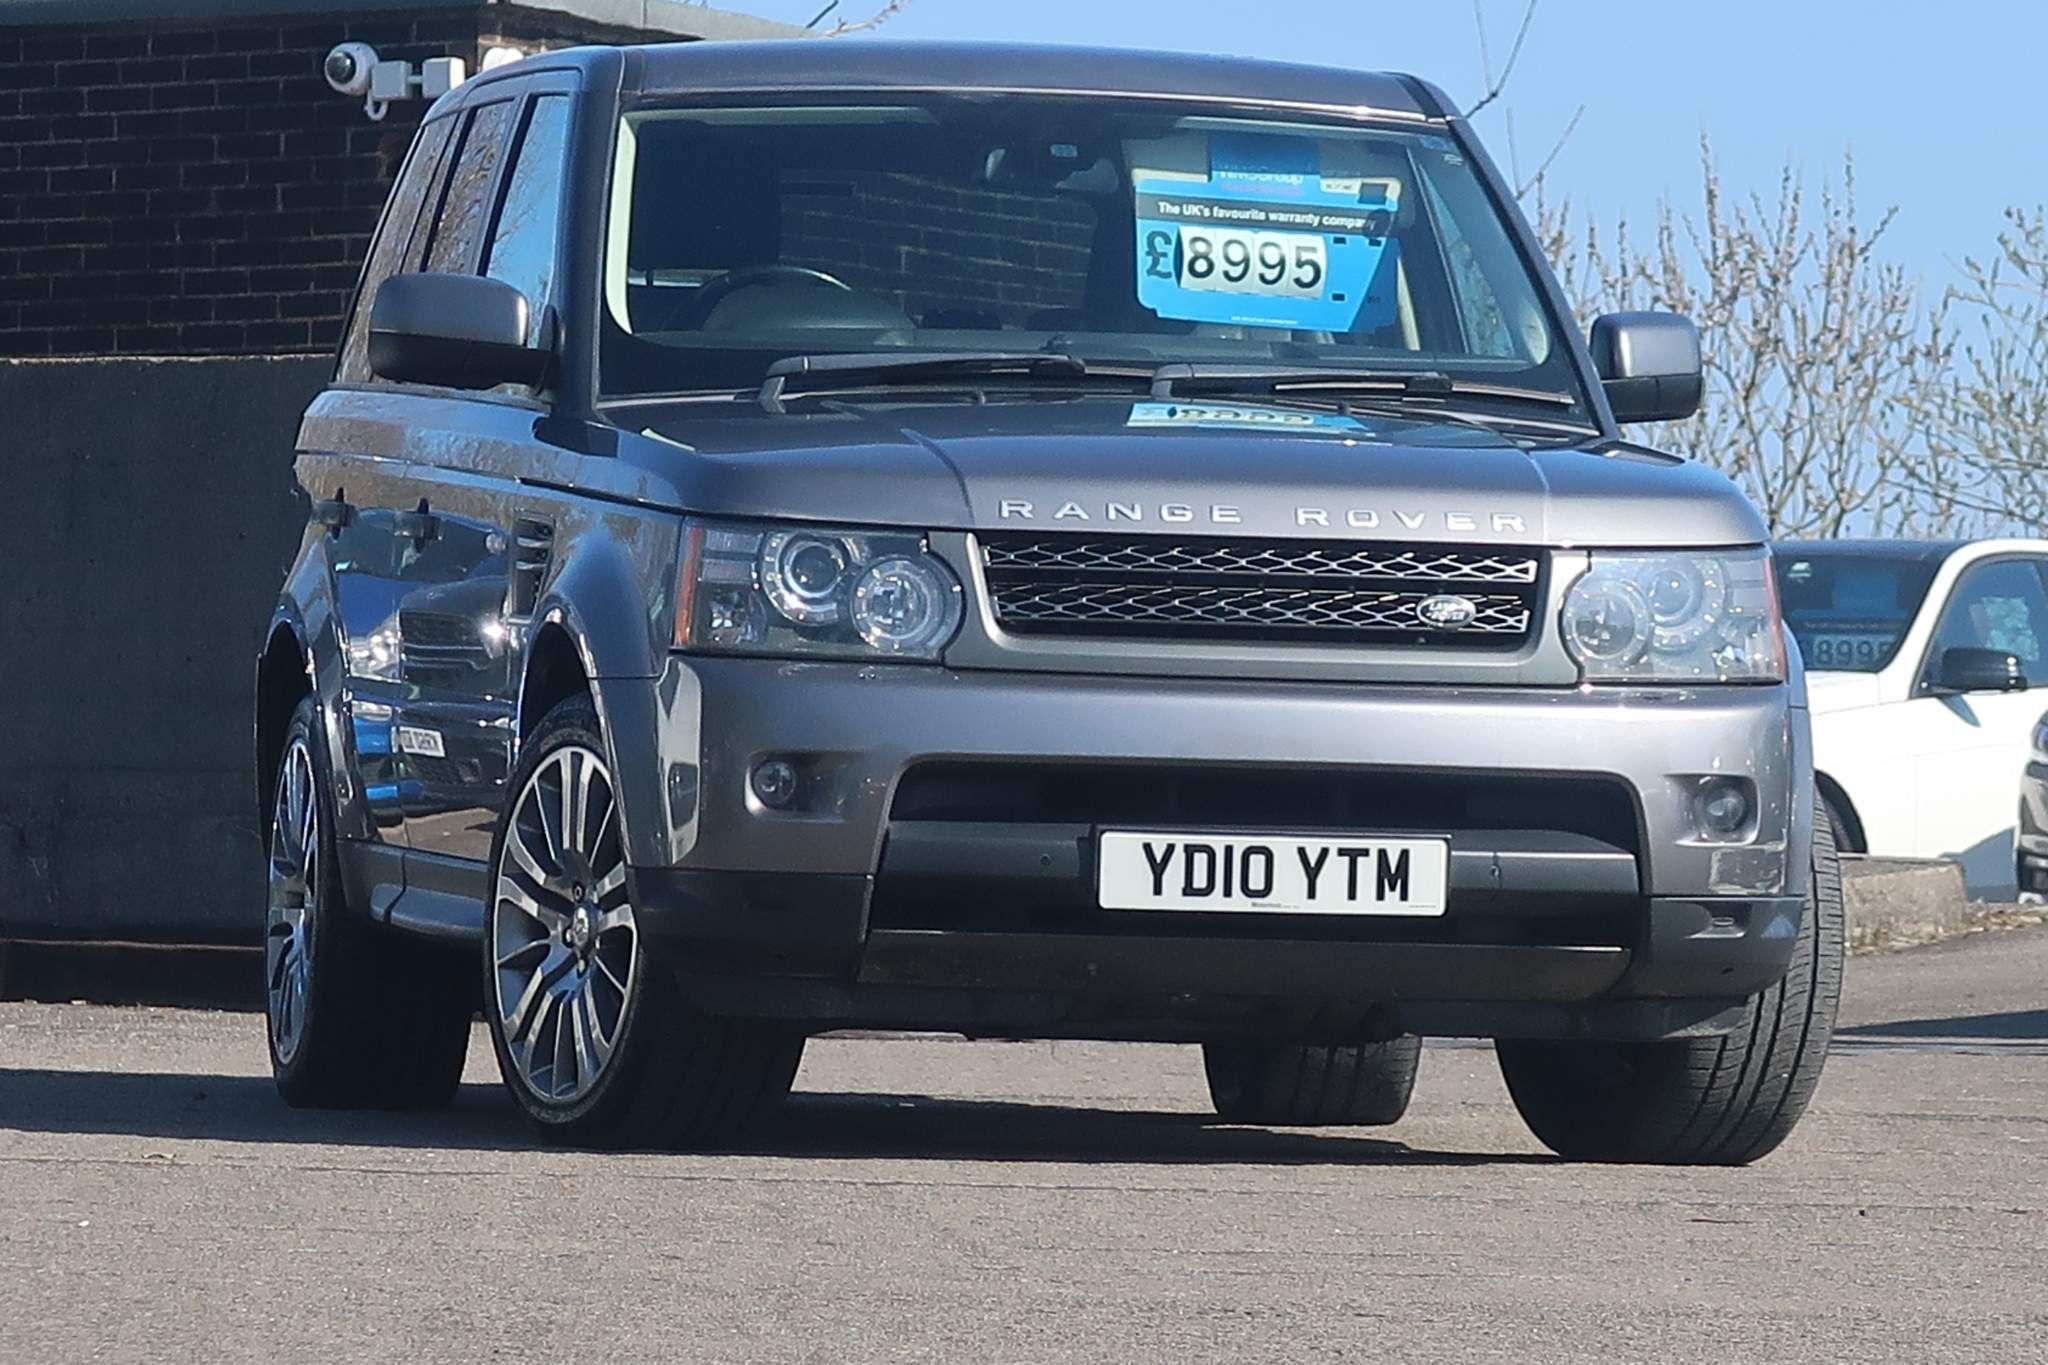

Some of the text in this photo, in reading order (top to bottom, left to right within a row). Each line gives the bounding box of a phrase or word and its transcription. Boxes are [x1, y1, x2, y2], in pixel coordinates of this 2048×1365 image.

[1158, 201, 1374, 230] The UK's favourite warranty compa
[1000, 499, 1526, 533] RANGE ROVER
[1142, 842, 1410, 902] YD10 YTM
